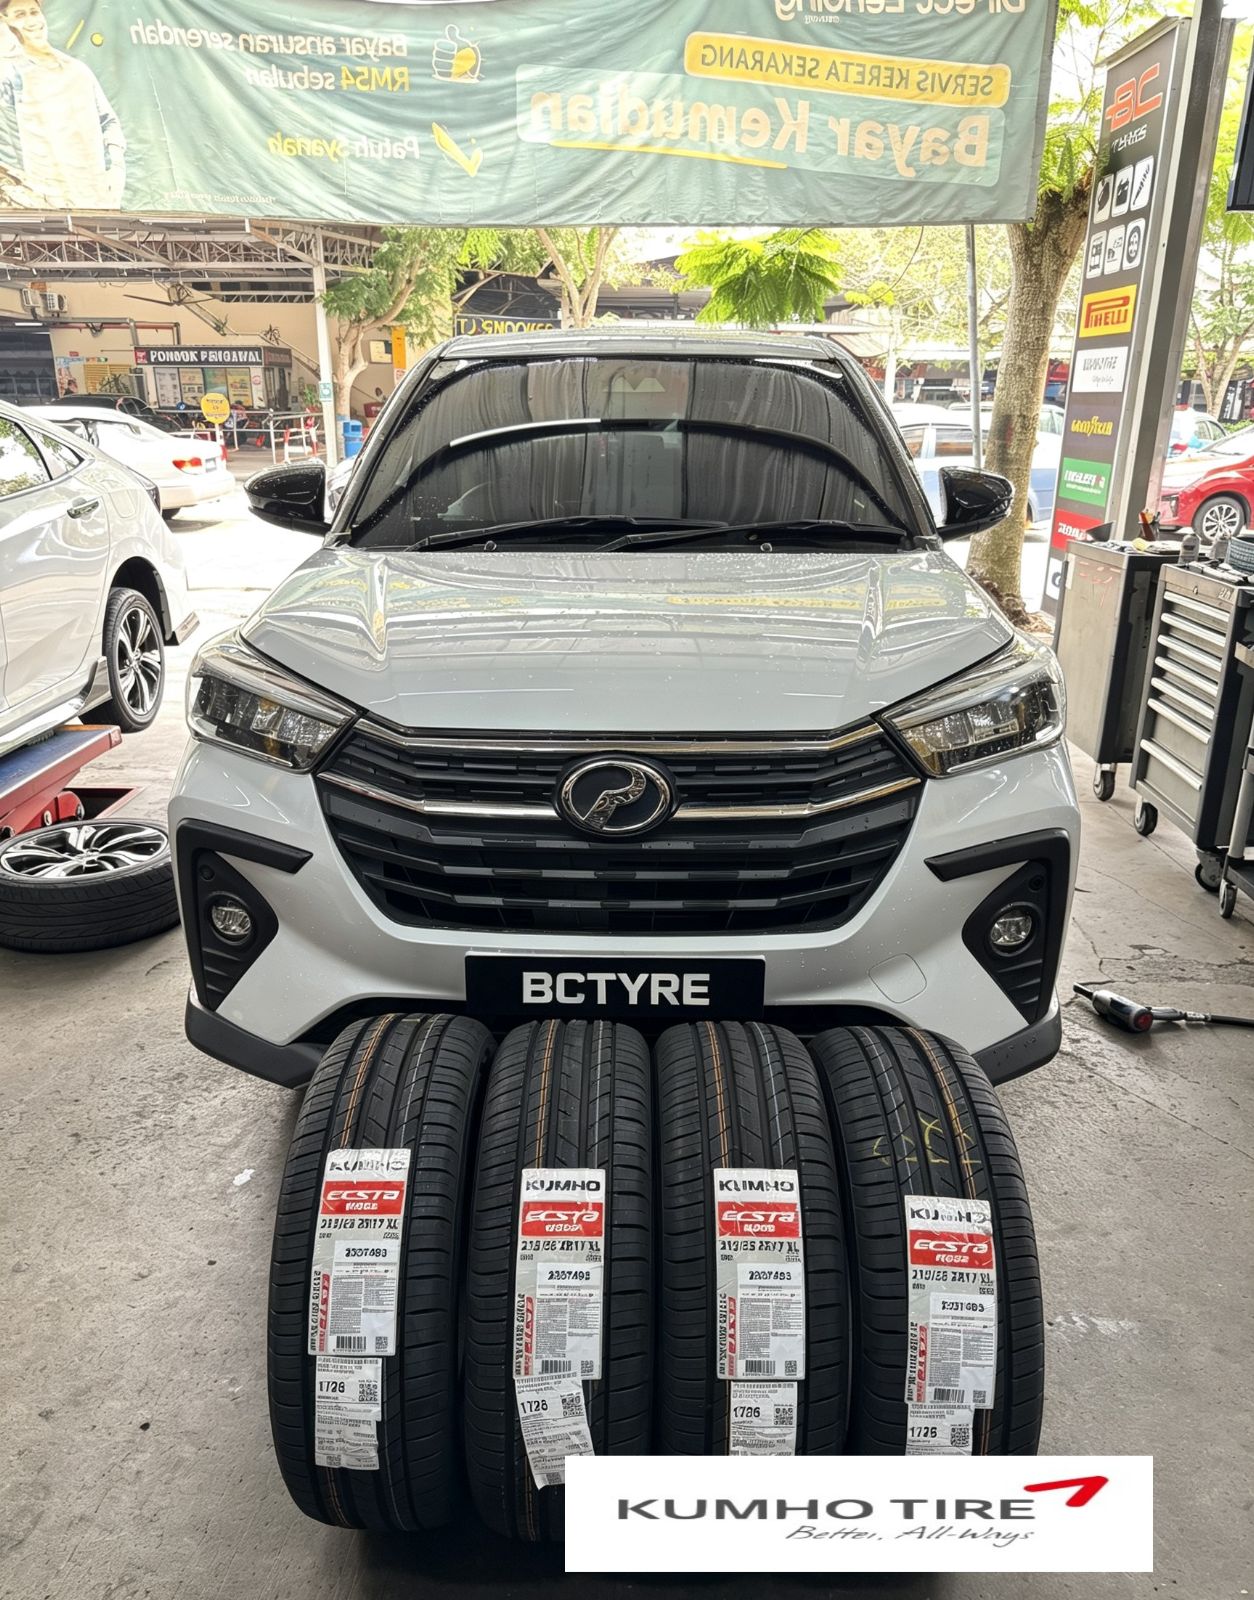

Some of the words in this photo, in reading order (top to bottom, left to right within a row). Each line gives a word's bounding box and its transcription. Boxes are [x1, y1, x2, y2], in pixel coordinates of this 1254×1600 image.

[150, 351, 198, 362] PONDOK
[522, 971, 710, 1005] BCTYRE
[526, 1180, 601, 1192] KUMHO
